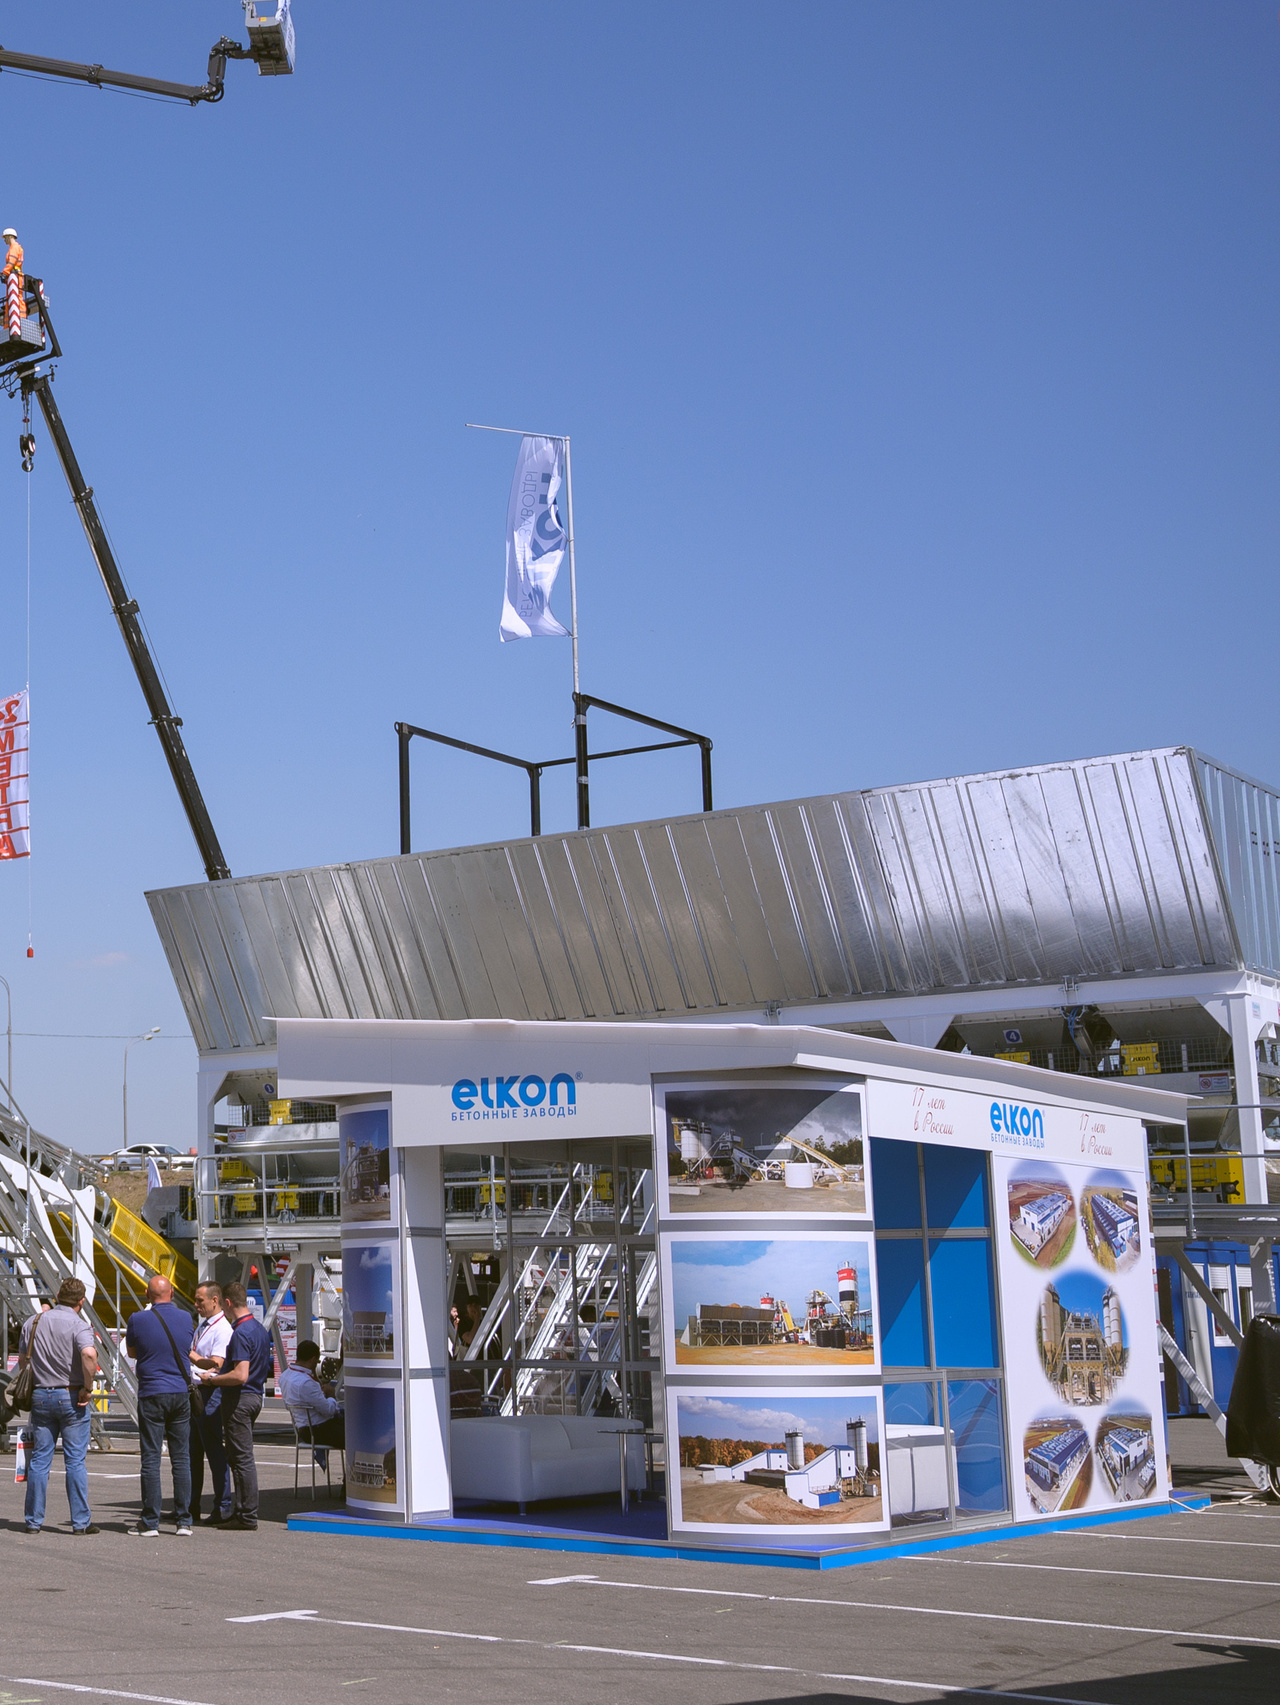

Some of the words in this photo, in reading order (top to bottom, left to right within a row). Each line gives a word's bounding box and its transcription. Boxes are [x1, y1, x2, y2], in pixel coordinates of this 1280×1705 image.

[451, 1072, 576, 1111] elkon
[912, 1086, 925, 1110] 17
[451, 1108, 518, 1121] БЕТОННЫЕ
[523, 1105, 577, 1118] ЗАВОДЫ
[922, 1111, 954, 1135] России
[990, 1102, 1044, 1139] elkon
[1079, 1113, 1090, 1131] 17
[990, 1133, 1021, 1146] БЕТОННЫЕ
[1022, 1137, 1045, 1149] ЗАВОДЫ
[1087, 1135, 1113, 1156] России
